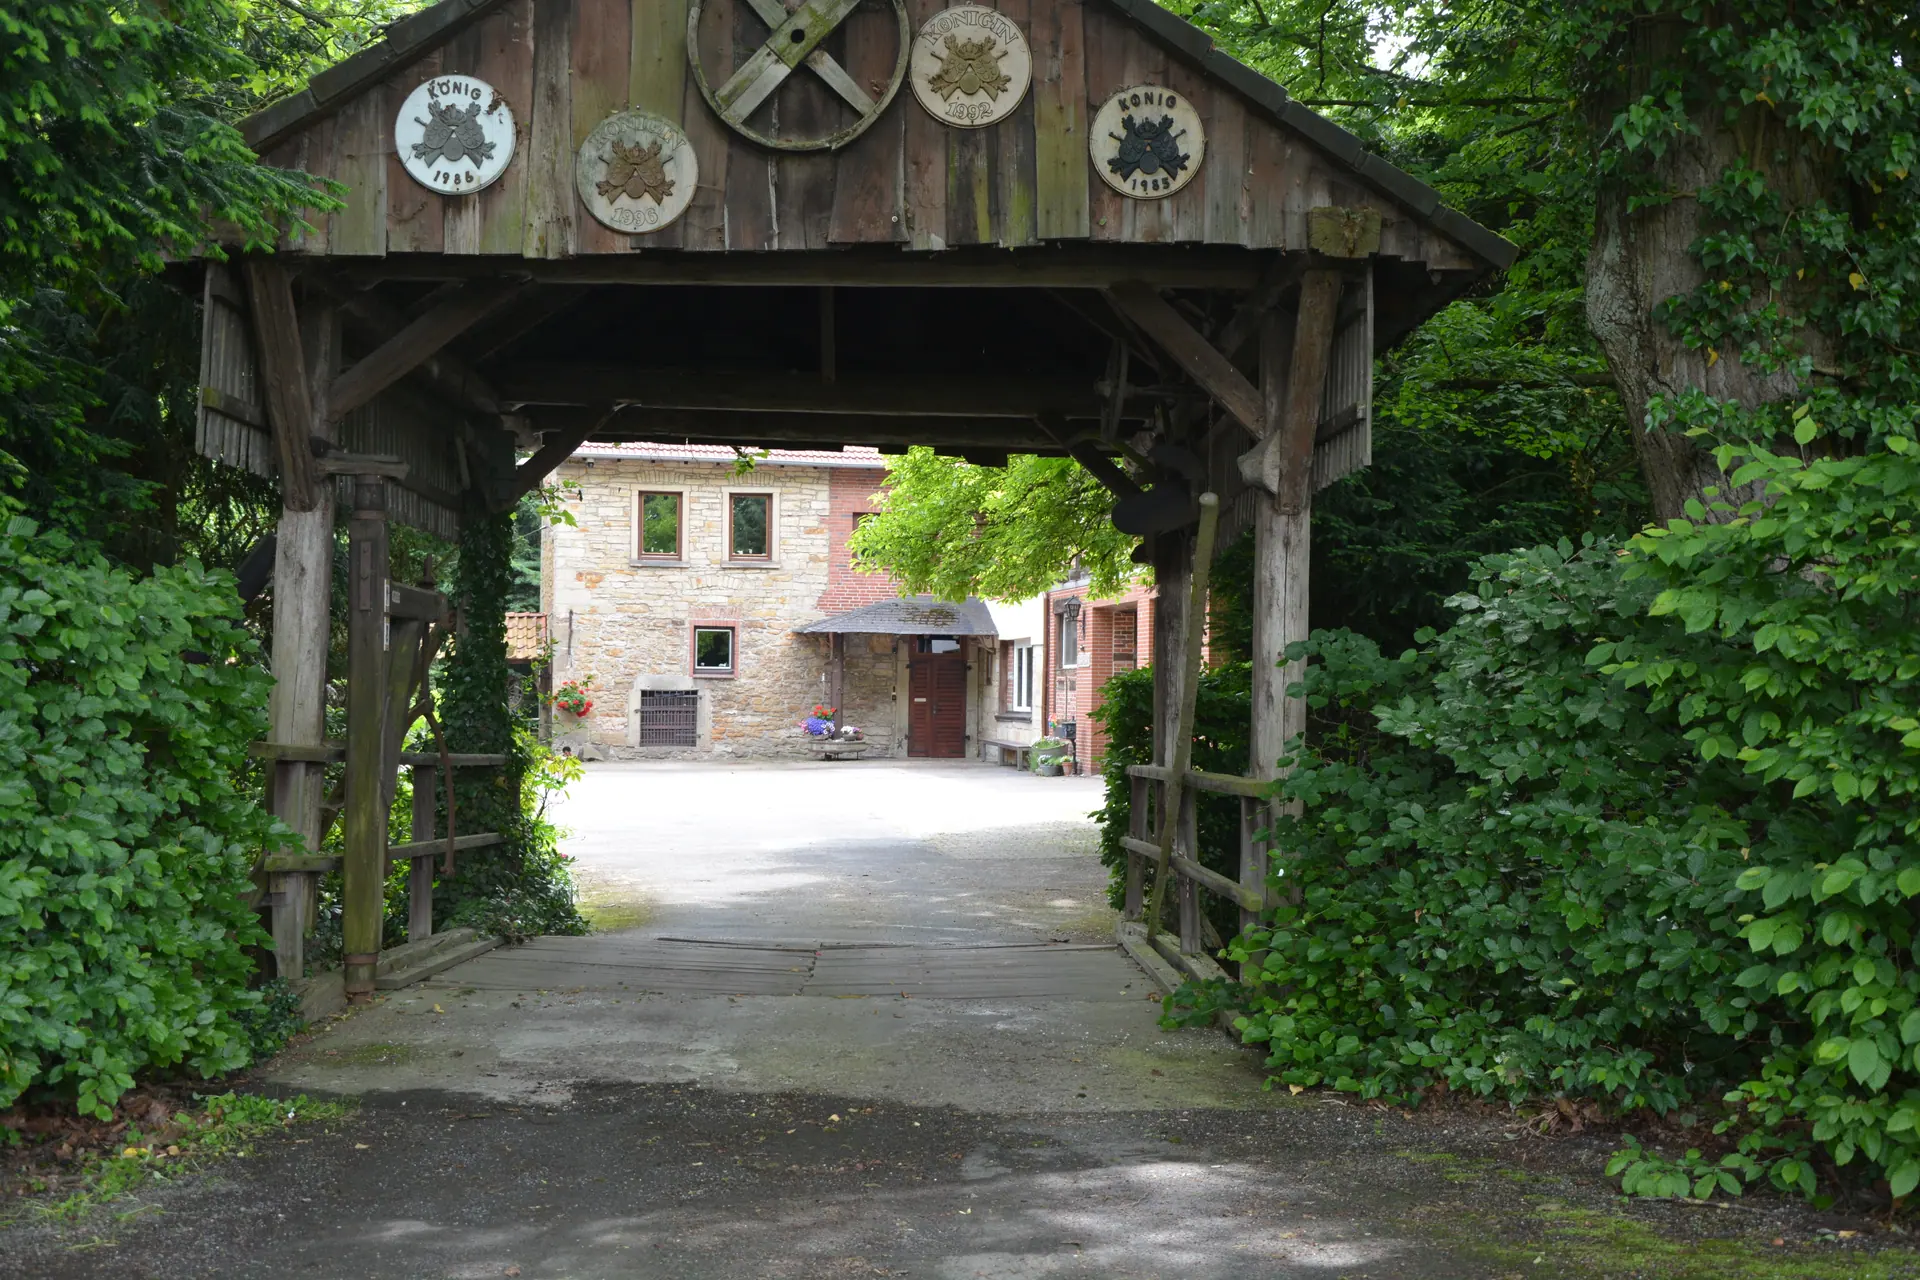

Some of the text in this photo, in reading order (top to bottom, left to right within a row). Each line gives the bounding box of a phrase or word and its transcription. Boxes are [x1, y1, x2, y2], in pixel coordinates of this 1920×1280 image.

[427, 80, 481, 100] KÖNIG
[945, 102, 993, 120] 1992
[433, 171, 474, 184] 1986
[1132, 177, 1170, 191] 1985
[611, 207, 658, 226] 1996
